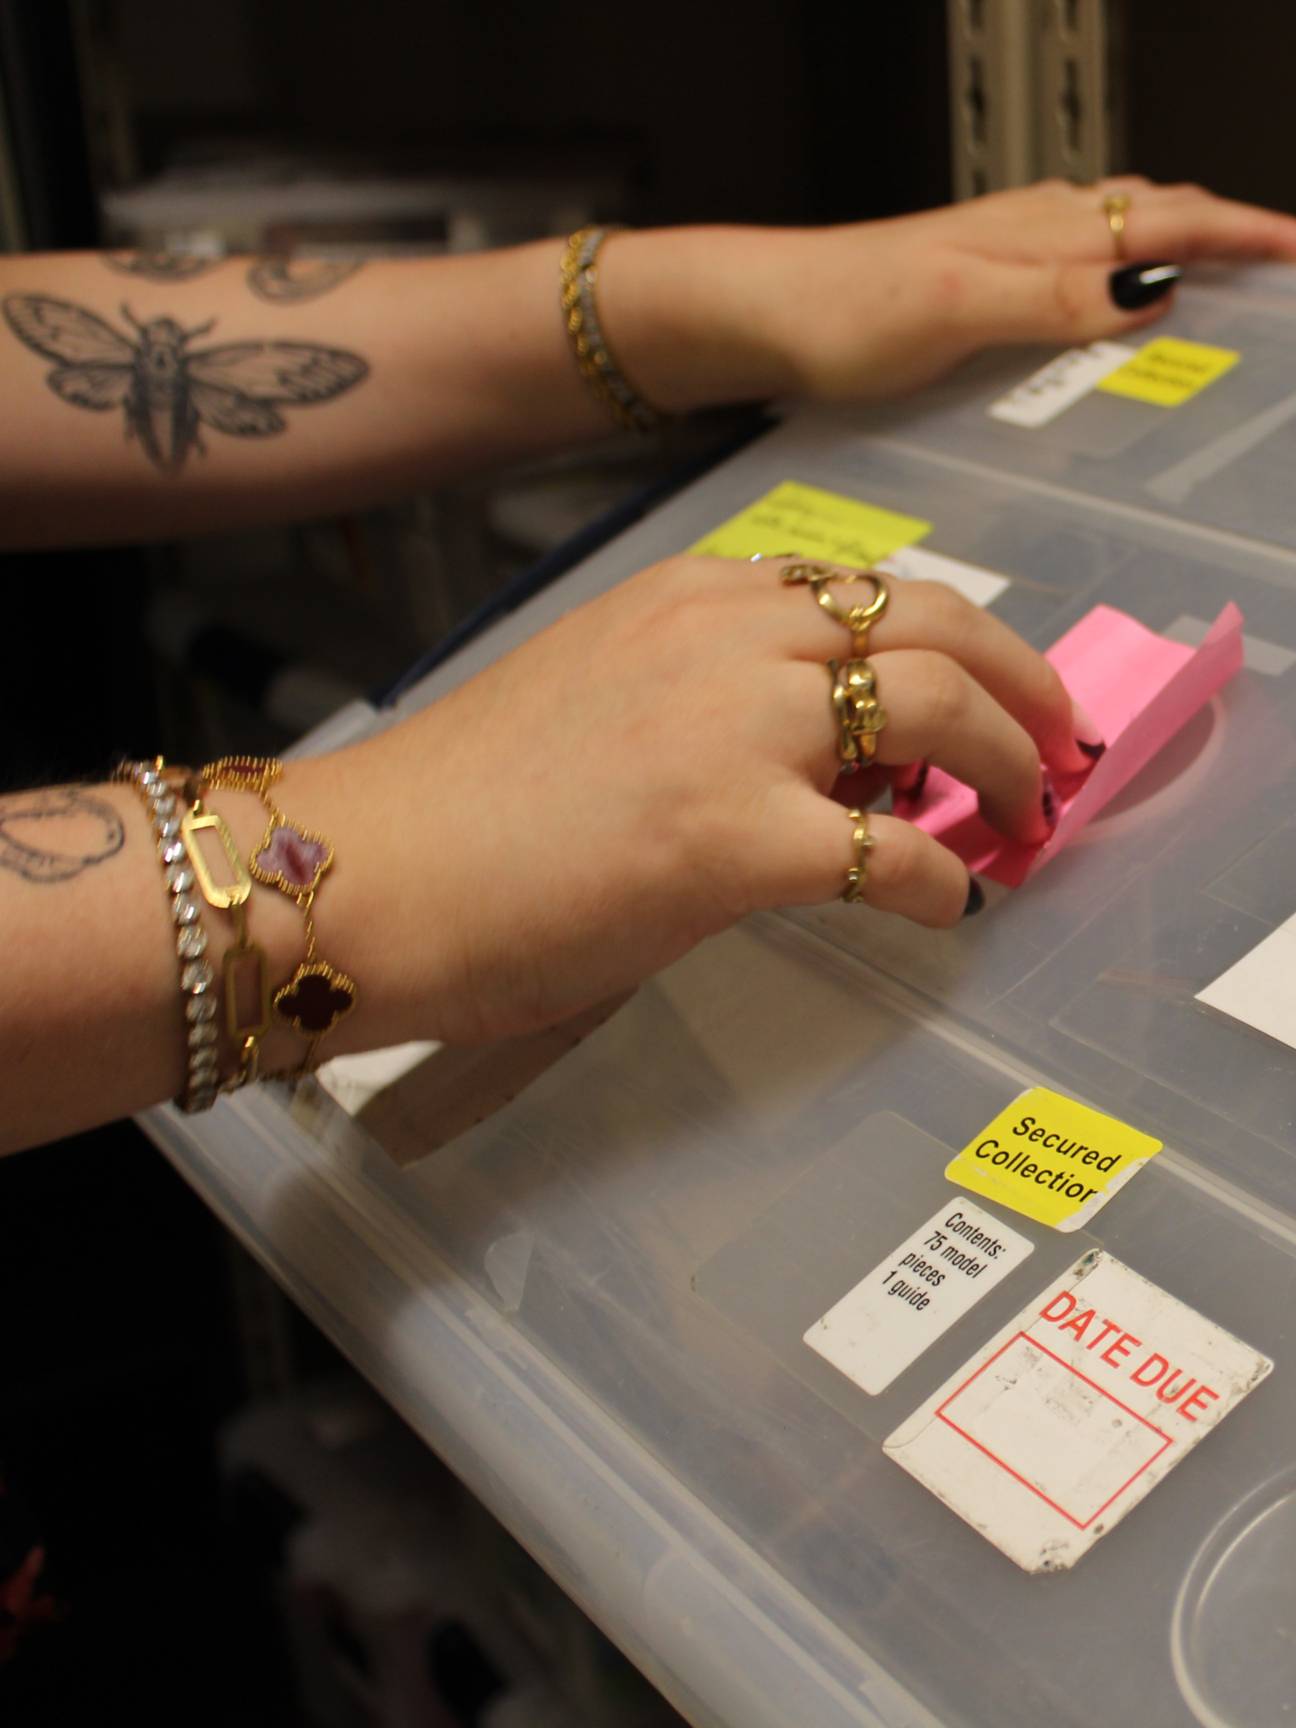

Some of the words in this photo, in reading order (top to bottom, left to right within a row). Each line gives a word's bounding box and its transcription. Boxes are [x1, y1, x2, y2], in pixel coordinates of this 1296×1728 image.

[1012, 1117, 1122, 1172] Secured
[923, 1230, 948, 1252] 75
[940, 1246, 988, 1278] model
[945, 1212, 1006, 1259] Contents:
[882, 1270, 898, 1285] 1
[898, 1251, 946, 1287] pieces
[887, 1279, 930, 1311] guide
[1038, 1290, 1143, 1369] DATE
[1129, 1353, 1220, 1422] DUE
